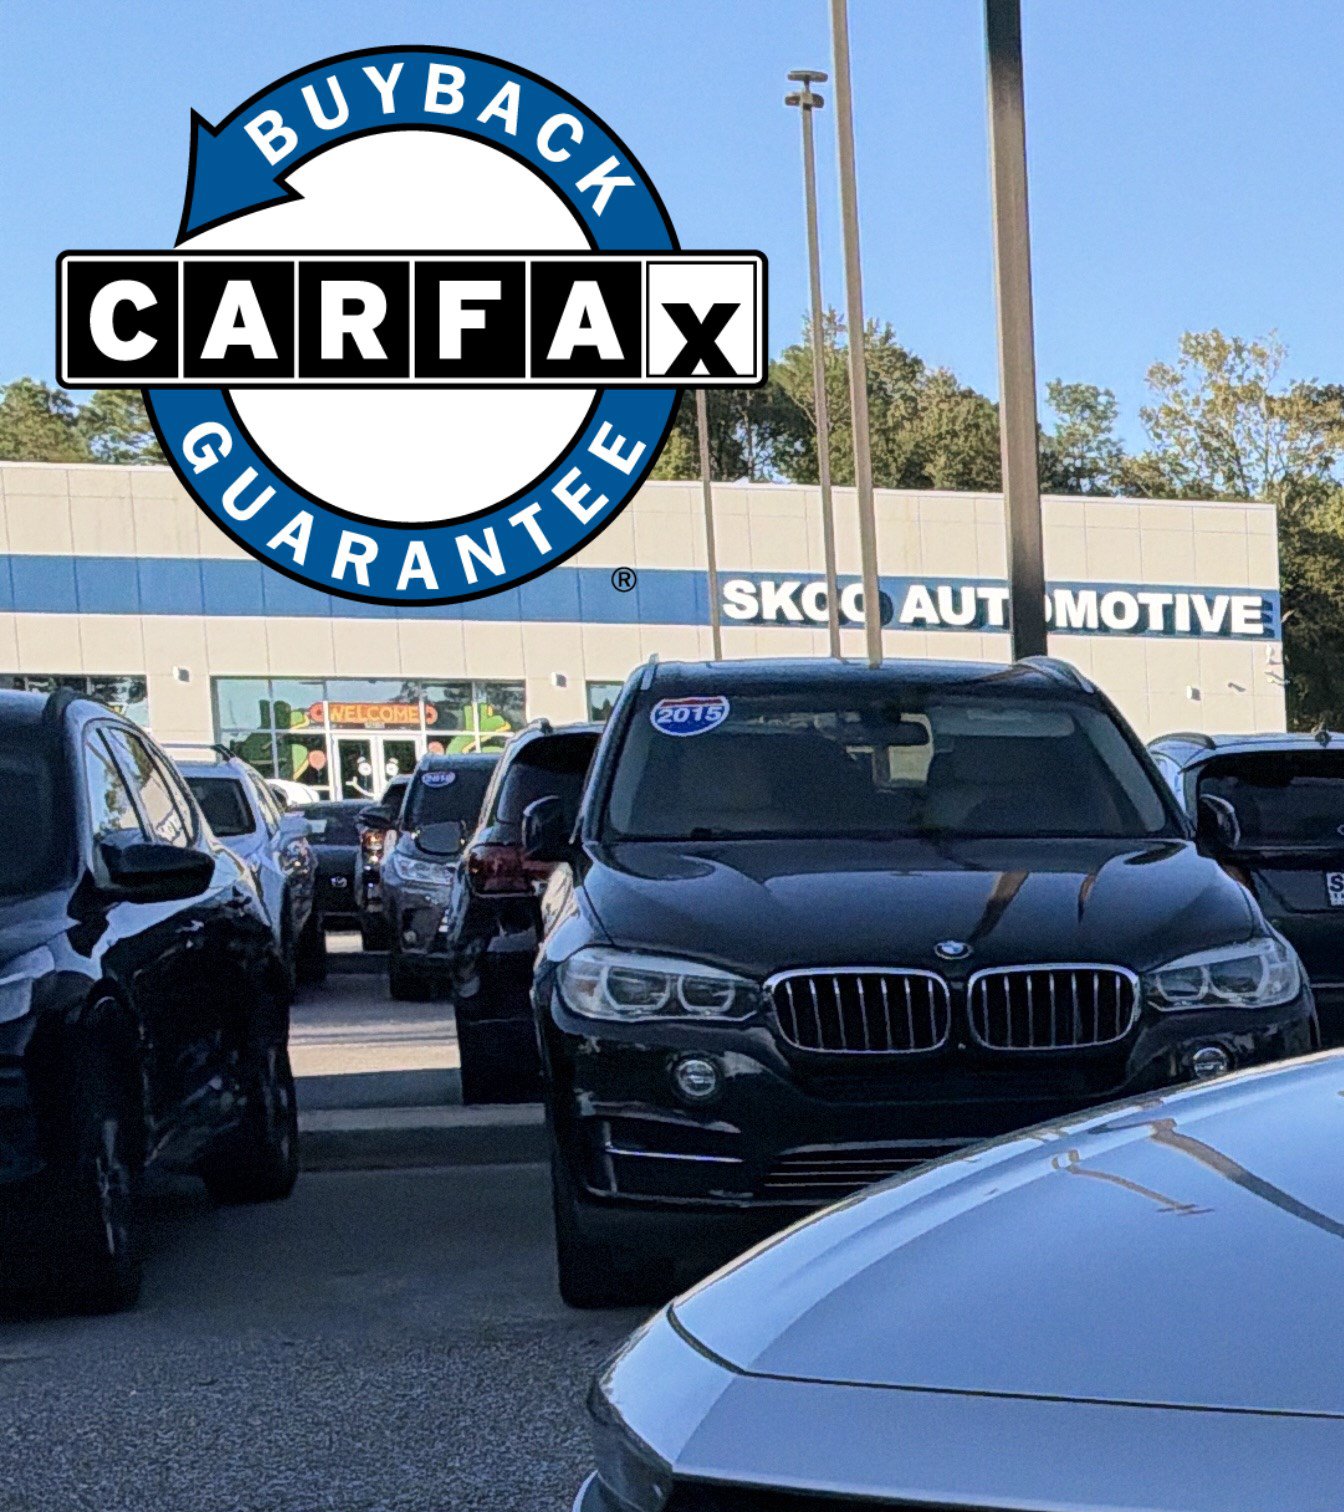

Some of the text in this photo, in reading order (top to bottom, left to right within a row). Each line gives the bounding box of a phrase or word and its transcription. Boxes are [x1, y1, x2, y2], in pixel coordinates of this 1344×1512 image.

[899, 584, 1264, 635] AUTMOTIVE
[330, 704, 420, 723] WELCOME
[657, 706, 722, 723] 2015
